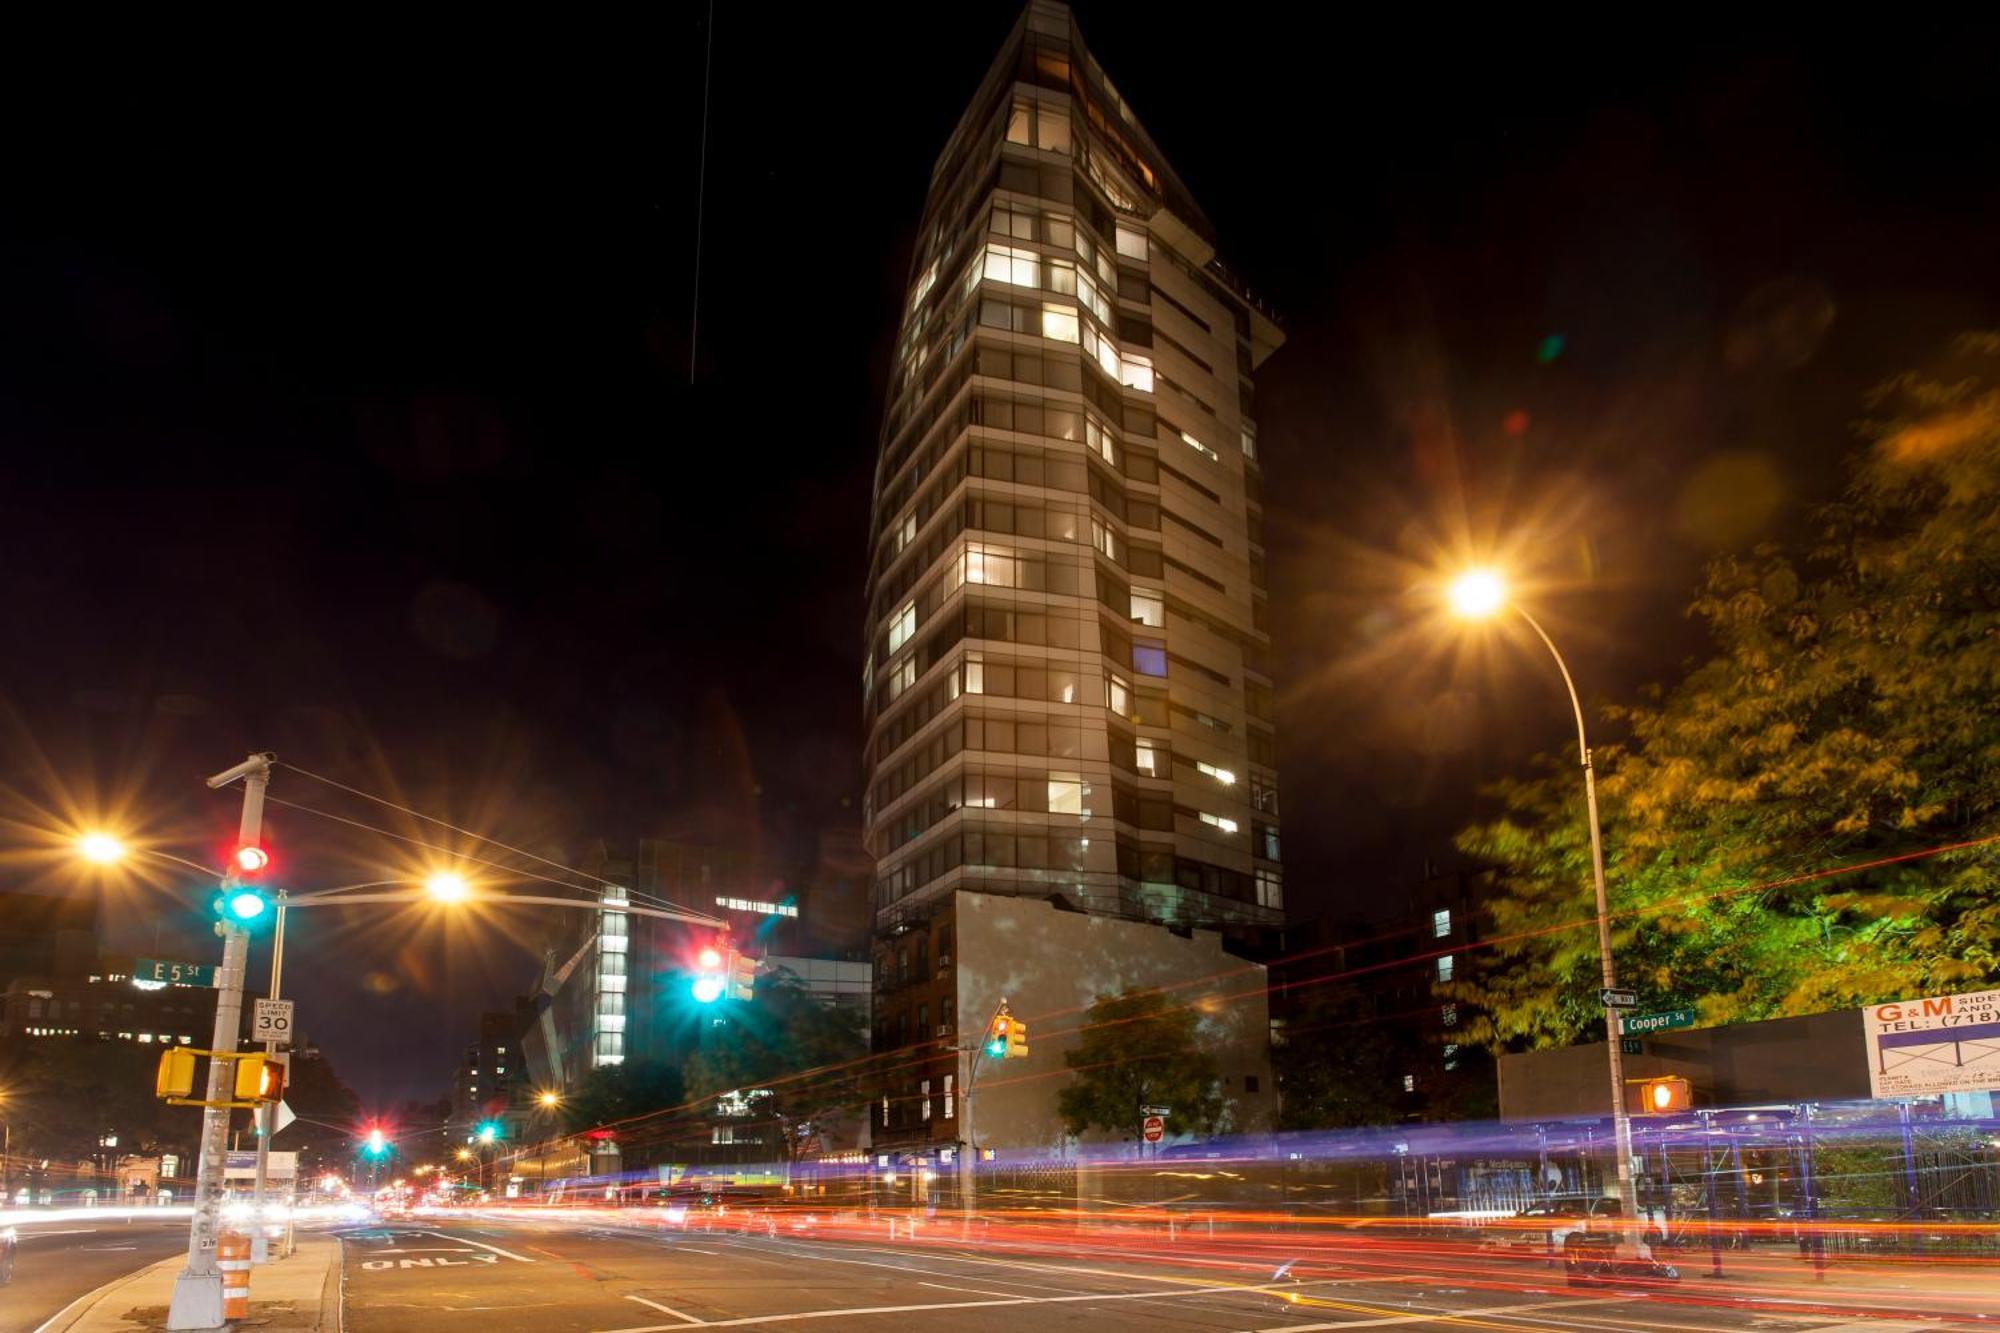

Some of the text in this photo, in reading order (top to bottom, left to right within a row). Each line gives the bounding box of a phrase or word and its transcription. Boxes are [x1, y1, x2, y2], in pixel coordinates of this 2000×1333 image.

[154, 963, 199, 981] E 5 St
[258, 1002, 290, 1010] SPEED
[1876, 997, 1952, 1022] G & M
[1958, 1003, 1992, 1013] AND
[259, 1016, 288, 1030] 30
[1630, 1012, 1685, 1030] Cooper Sq
[1880, 1010, 2000, 1032] TEL: (718)
[361, 1253, 498, 1270] ONLY
